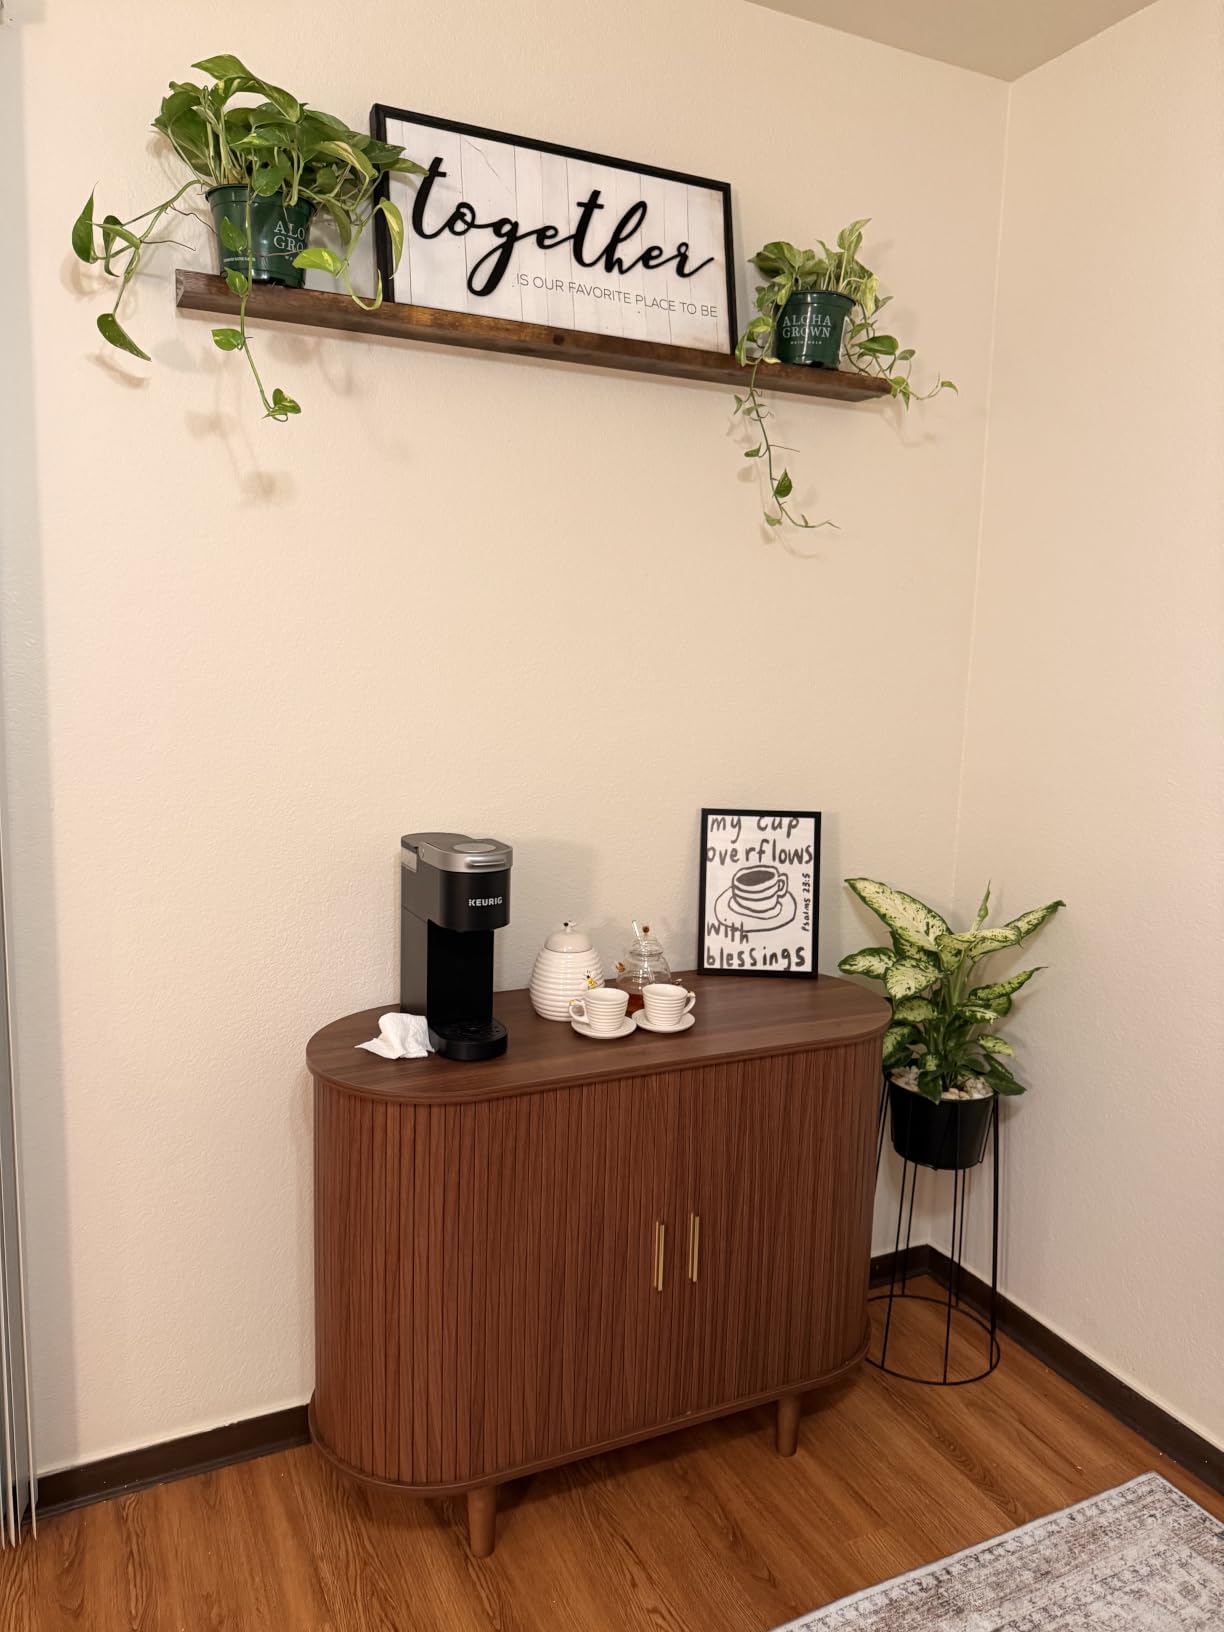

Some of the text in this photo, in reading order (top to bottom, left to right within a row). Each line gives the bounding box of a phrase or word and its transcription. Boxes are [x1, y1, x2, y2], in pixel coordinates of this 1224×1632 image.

[411, 156, 715, 297] together
[516, 273, 718, 318] IS OUR FAVORITE PLACE TO BE
[782, 326, 831, 338] GROWN
[783, 314, 832, 327] ALOHA
[710, 816, 800, 844] my cup
[706, 838, 814, 866] overflows
[468, 896, 503, 907] KEURIG
[801, 872, 811, 932] Psalms 23:5
[706, 918, 750, 945] with
[706, 946, 806, 971] blessings
